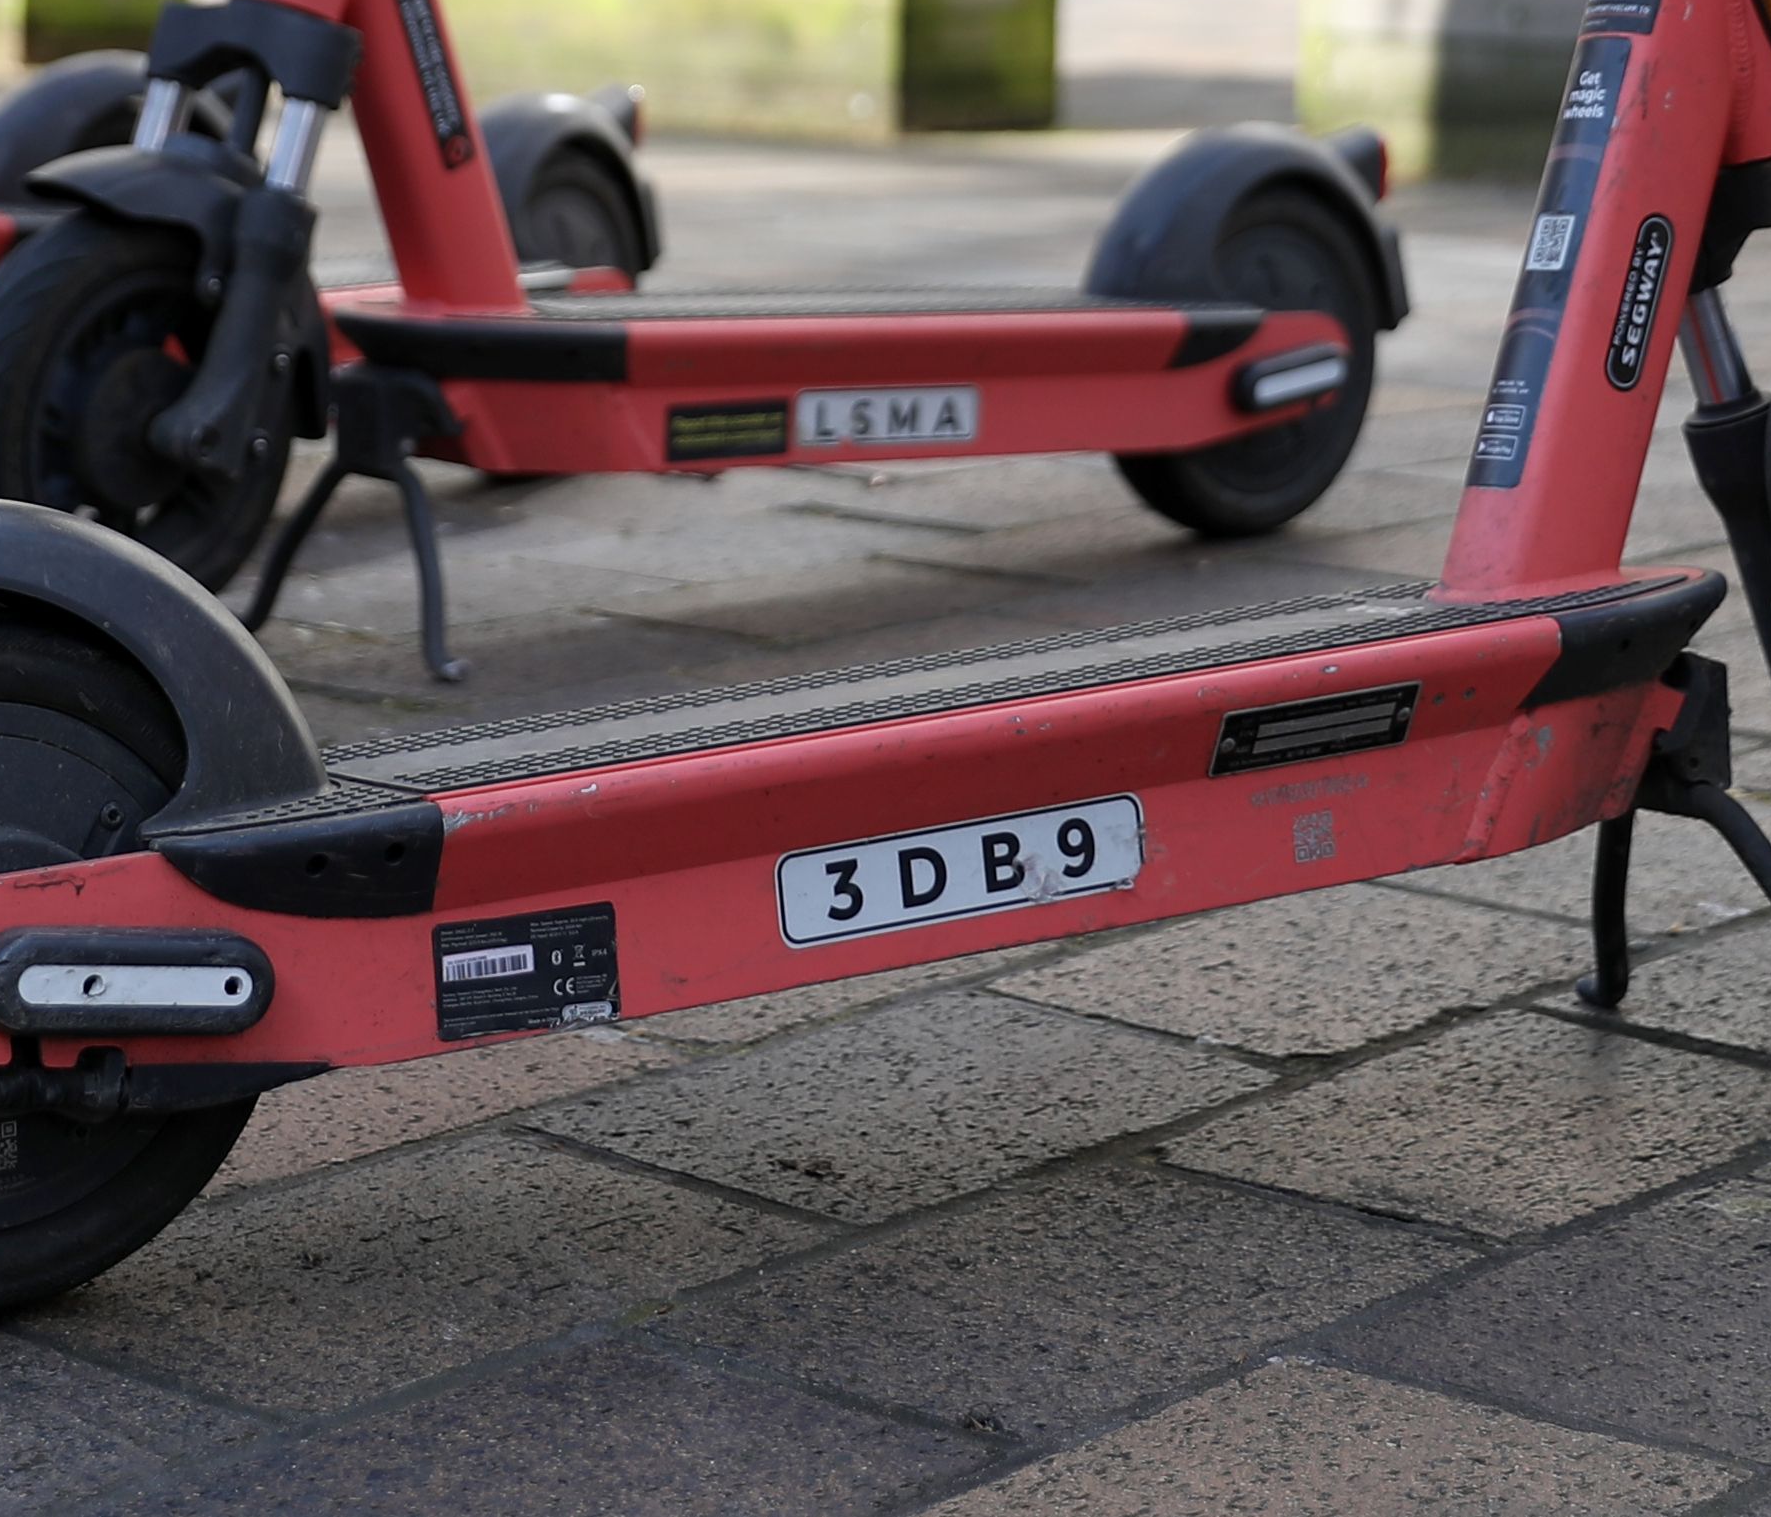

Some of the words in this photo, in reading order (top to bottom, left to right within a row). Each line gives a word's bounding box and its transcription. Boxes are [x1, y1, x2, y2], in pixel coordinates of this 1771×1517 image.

[1569, 86, 1607, 104] magic
[1580, 70, 1602, 85] Get
[1563, 103, 1605, 119] wheels
[1613, 270, 1638, 346] POWERED
[1632, 245, 1643, 267] BY
[1622, 236, 1662, 367] SEGWAY
[812, 395, 960, 436] LSMA
[825, 817, 1096, 921] 3DB9
